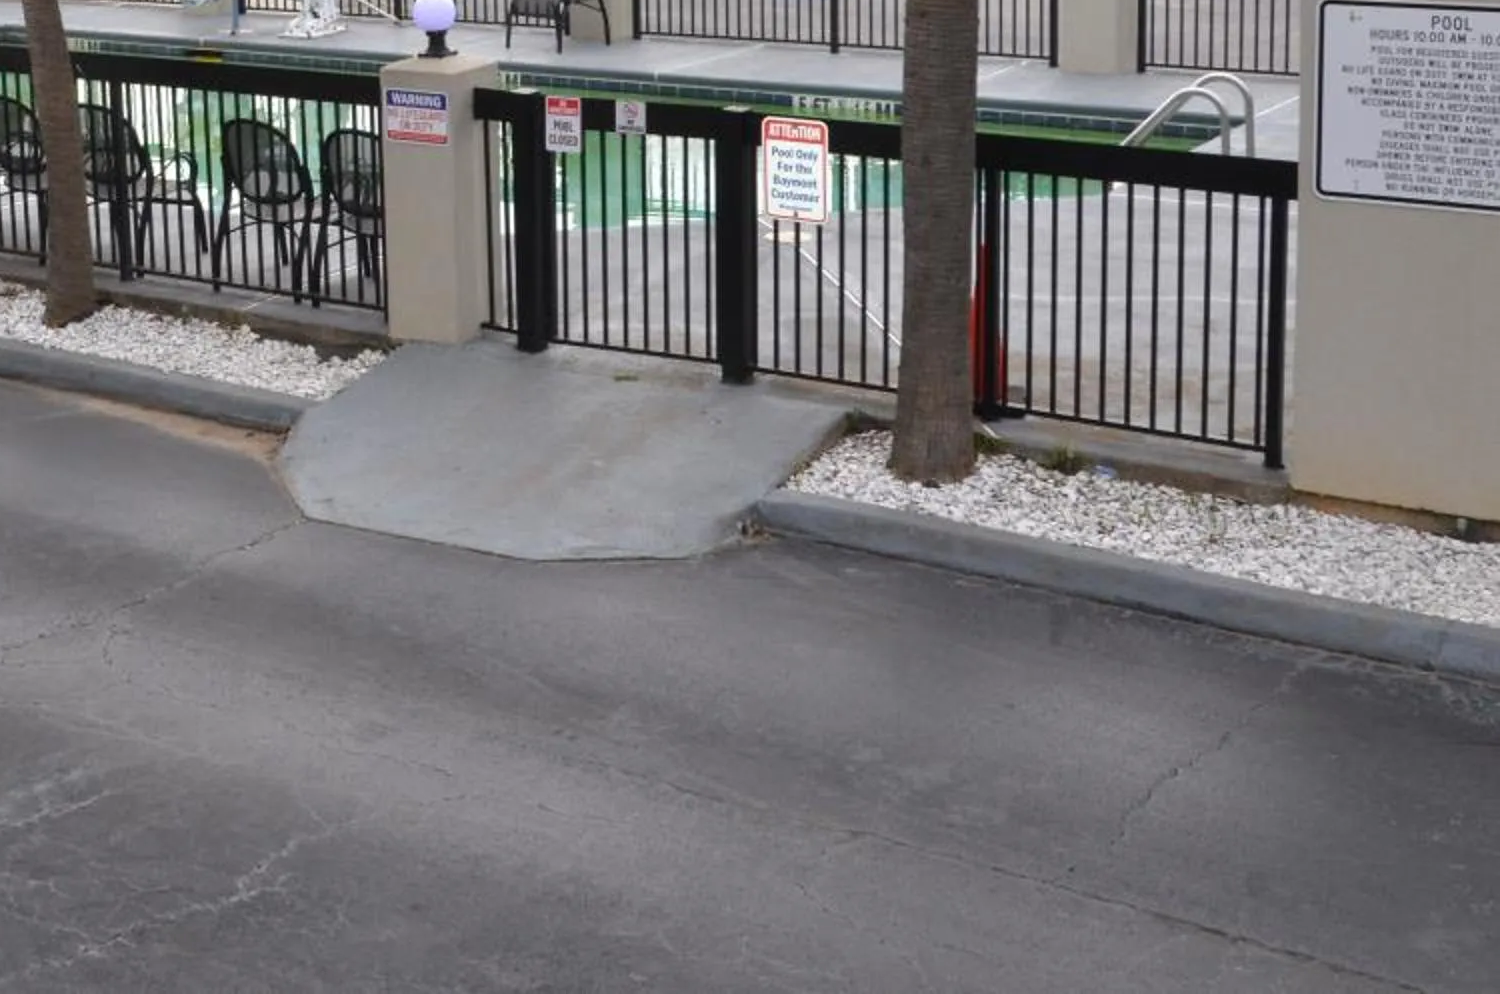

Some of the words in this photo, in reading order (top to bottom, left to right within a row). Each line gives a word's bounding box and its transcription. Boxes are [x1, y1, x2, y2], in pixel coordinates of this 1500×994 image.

[1430, 15, 1472, 31] POOL
[1369, 29, 1410, 41] HOURS
[1449, 33, 1467, 44] AM
[391, 91, 442, 108] WARNING
[769, 123, 821, 141] ATTENTION
[548, 133, 578, 147] CLOSED
[772, 146, 793, 159] Pool
[796, 149, 818, 161] Only
[777, 162, 793, 171] For
[796, 163, 812, 174] the
